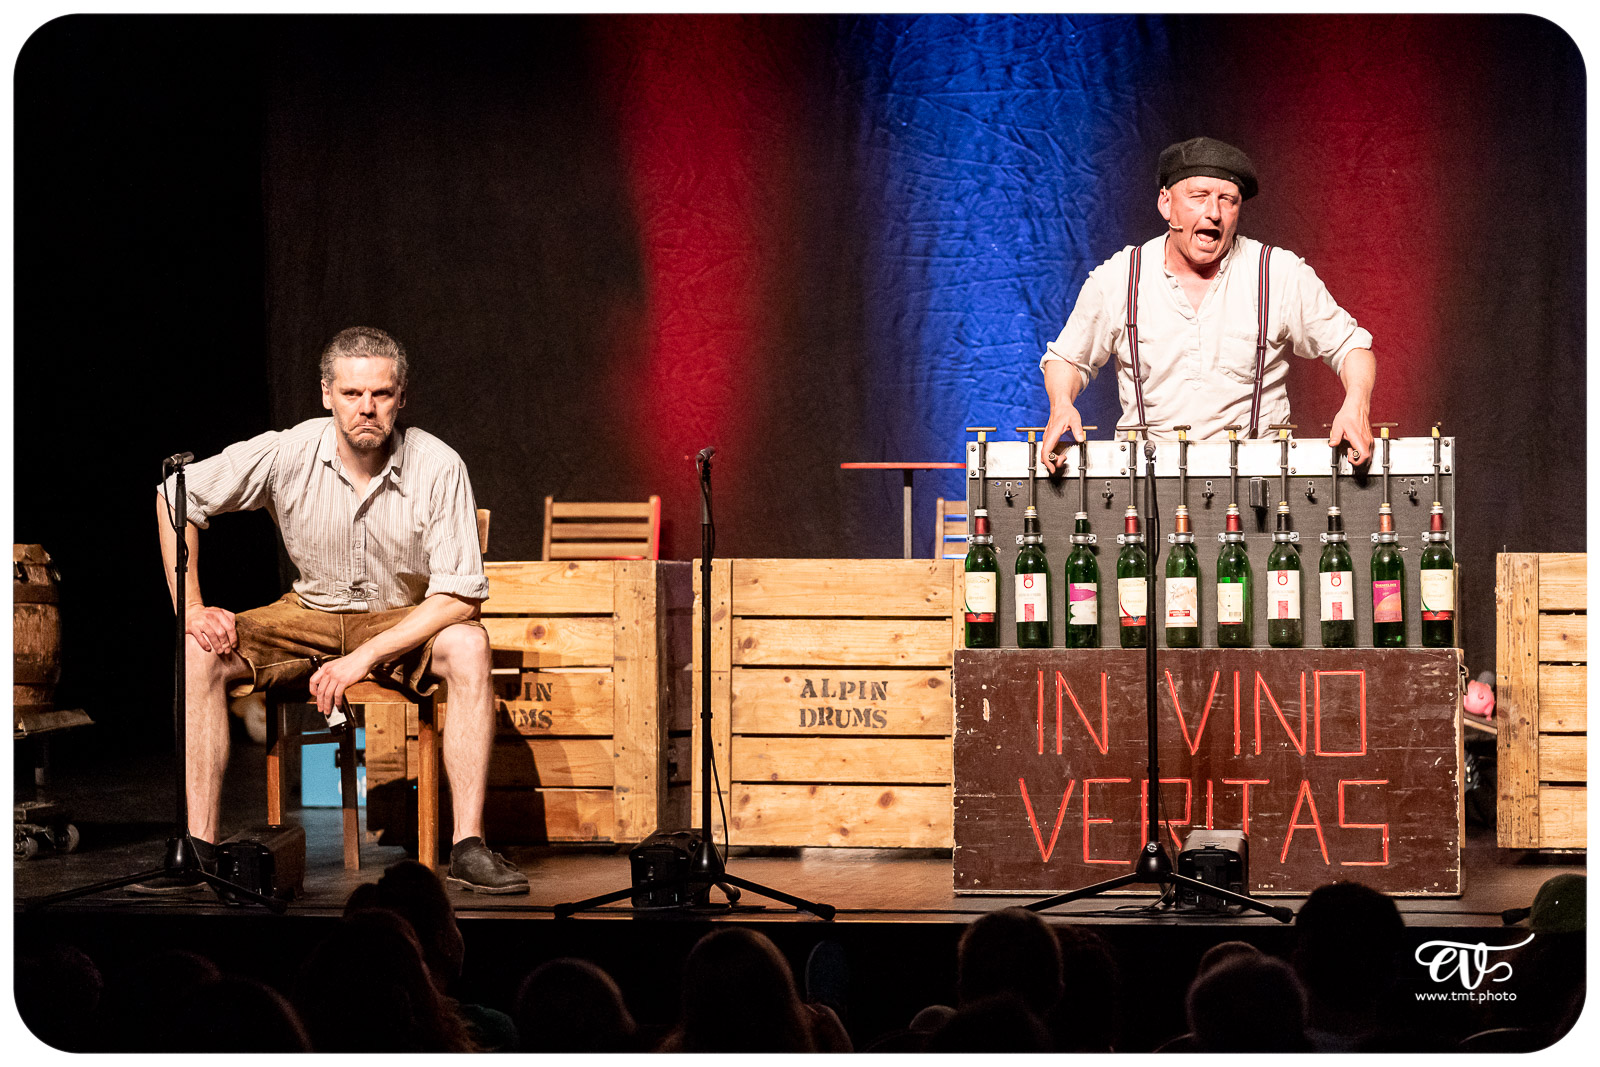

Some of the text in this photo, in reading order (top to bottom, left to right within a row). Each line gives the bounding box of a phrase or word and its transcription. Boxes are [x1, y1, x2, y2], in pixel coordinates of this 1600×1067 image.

[799, 706, 888, 729] DRUMS
[800, 678, 889, 701] ALPIN
[1037, 668, 1367, 757] IN VINO
[1019, 777, 1389, 866] VERITAS
